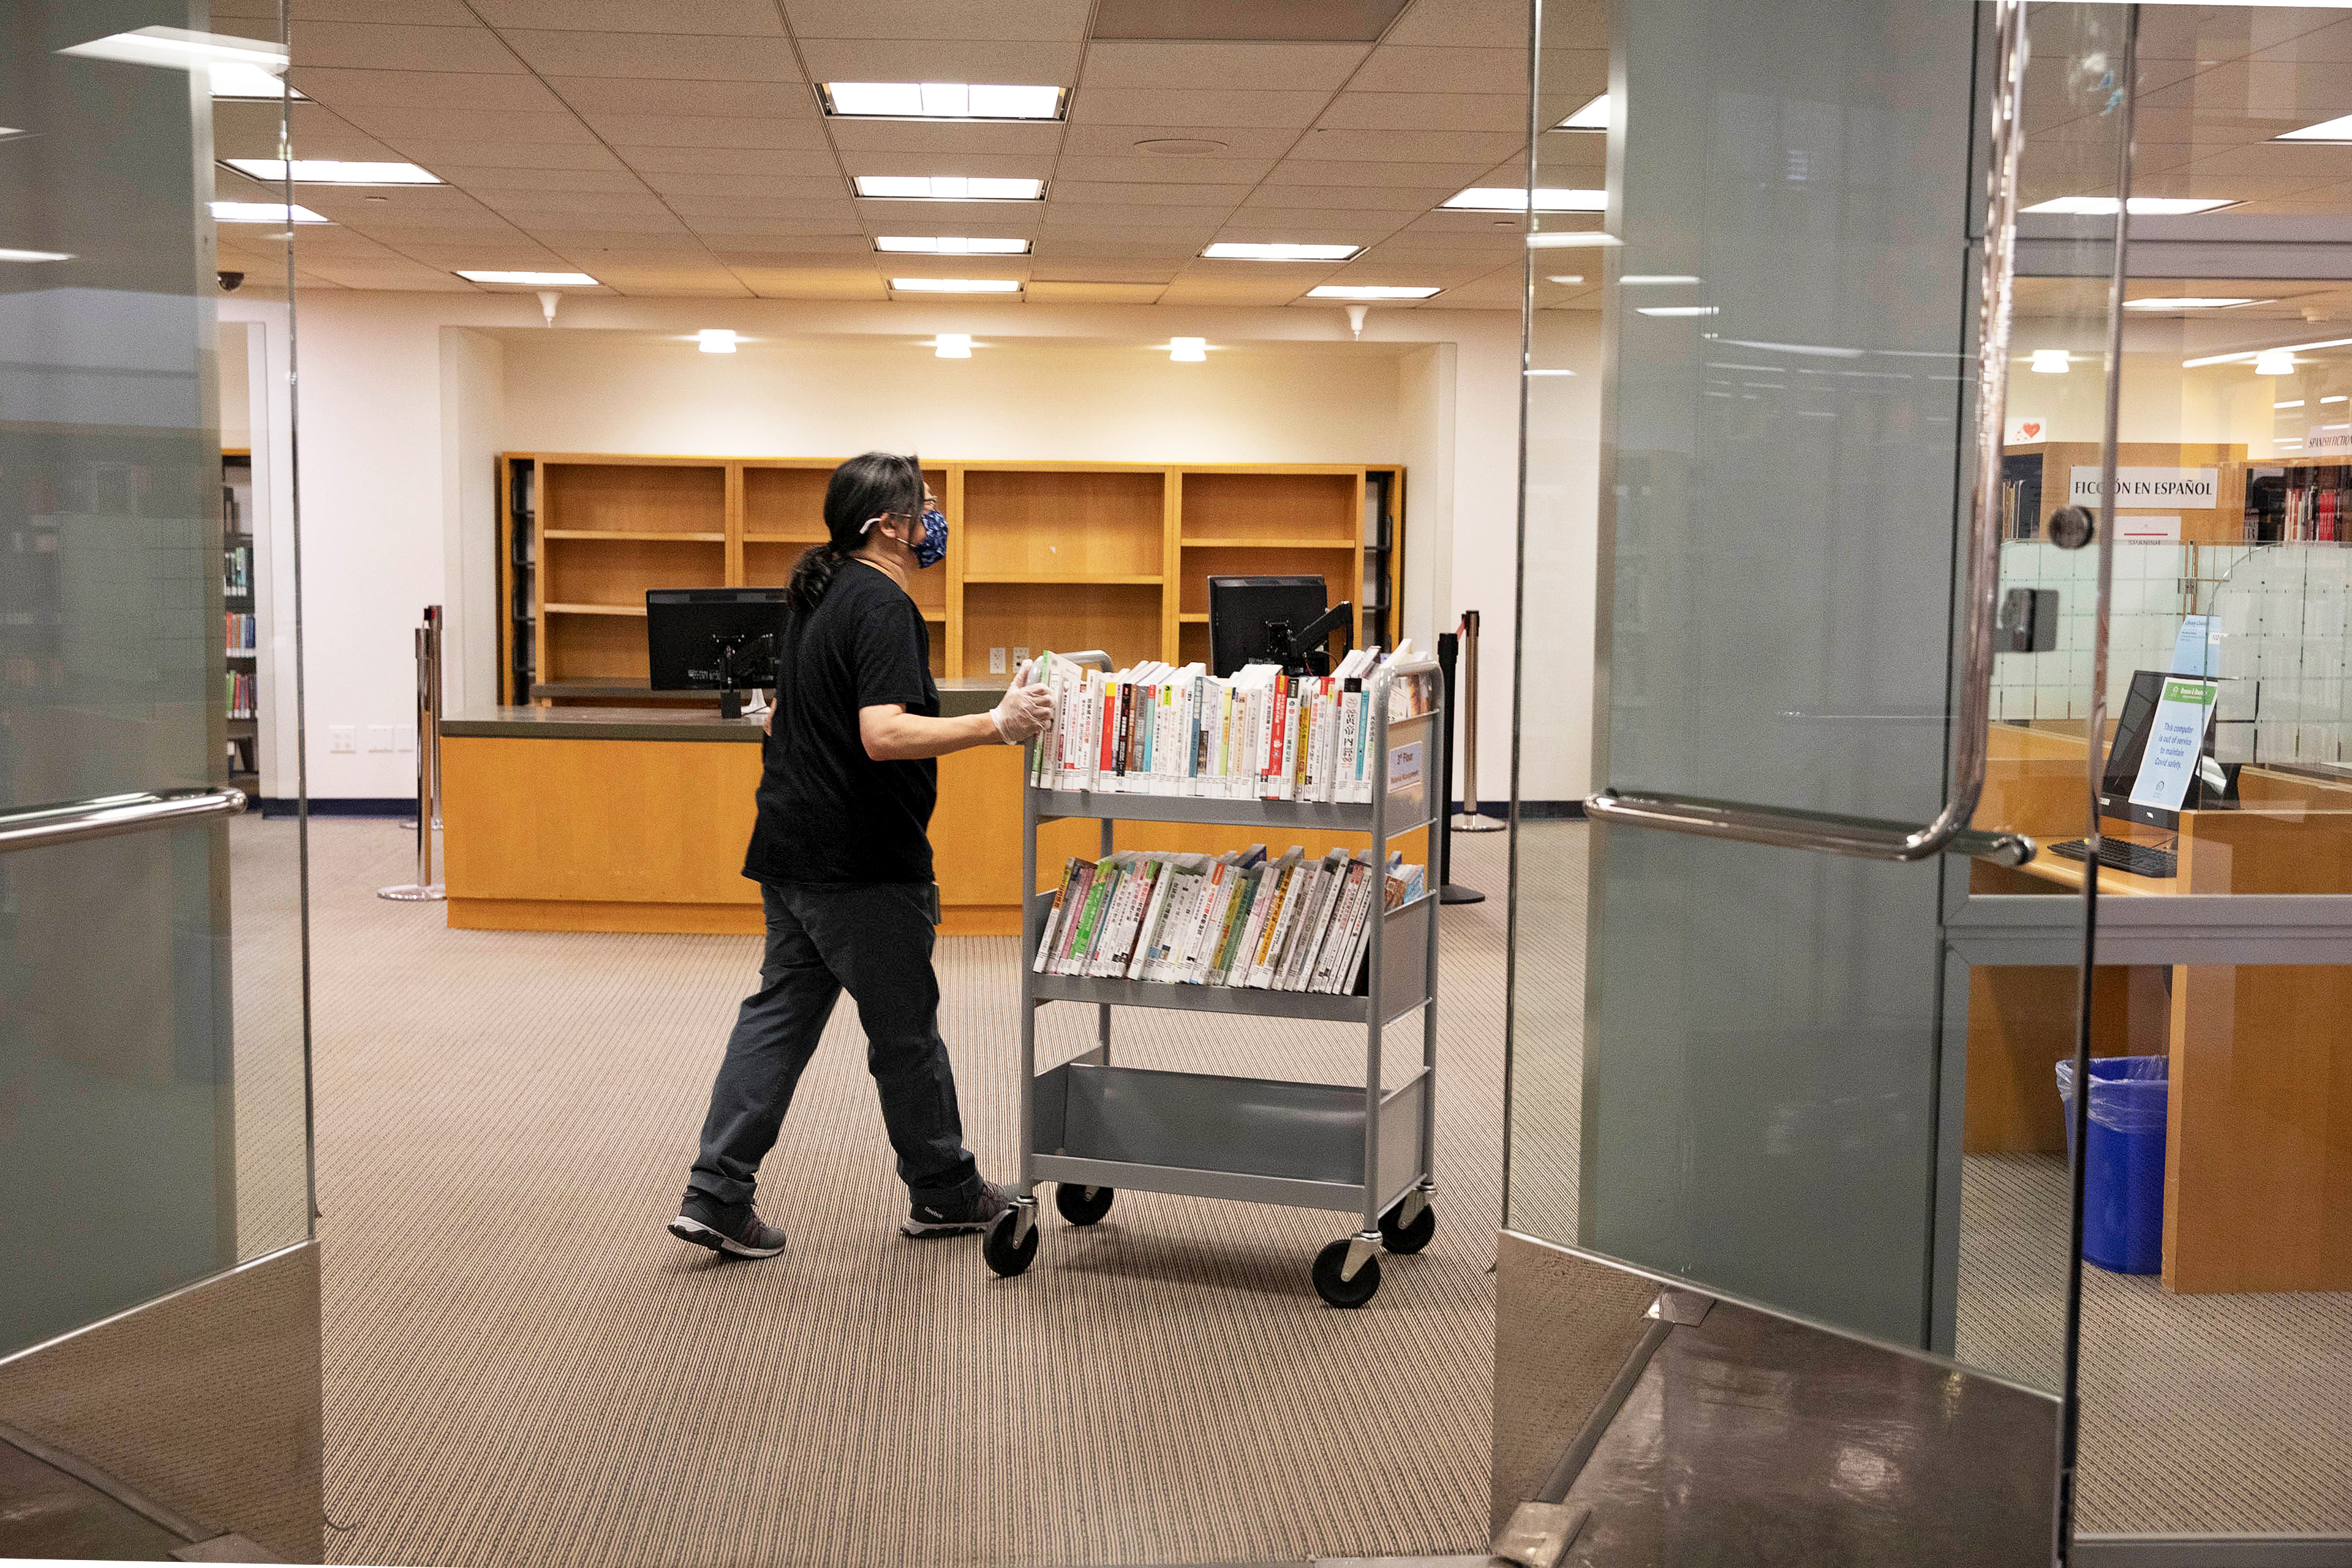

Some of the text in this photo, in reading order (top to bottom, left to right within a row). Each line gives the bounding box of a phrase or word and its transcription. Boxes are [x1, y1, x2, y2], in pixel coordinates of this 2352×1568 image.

[2308, 437, 2331, 448] SPANISH
[2075, 478, 2212, 496] FICCÓN EN ESPAÑOL
[2174, 725, 2193, 734] computer
[2171, 736, 2177, 745] of
[2165, 747, 2184, 756] maintain
[2155, 758, 2167, 767] Covid
[924, 1206, 944, 1219] Reebok
